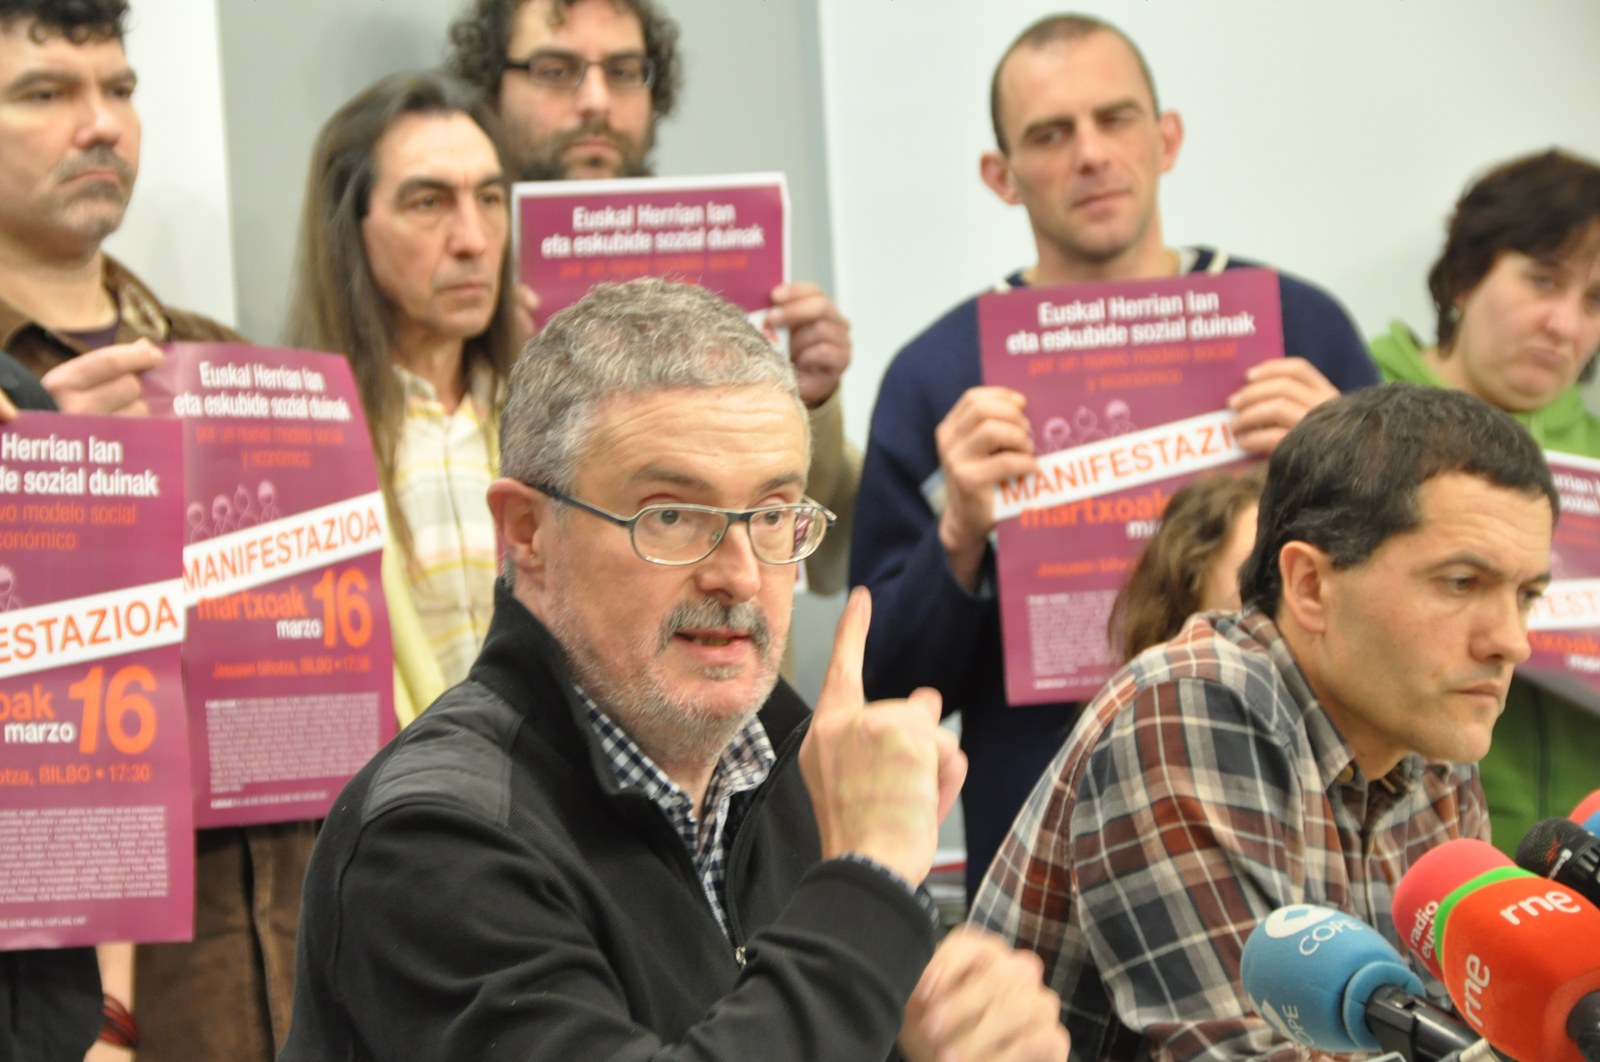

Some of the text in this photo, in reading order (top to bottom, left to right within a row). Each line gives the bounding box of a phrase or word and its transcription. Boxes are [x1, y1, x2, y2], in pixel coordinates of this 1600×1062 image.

[572, 204, 634, 231] Euskal
[637, 203, 704, 226] Herrian
[541, 223, 765, 258] eta eskubide sozial duinak
[1038, 298, 1105, 326] Euskal
[1110, 294, 1183, 319] Herrian
[1006, 312, 1255, 354] eta eskubide sozial duinak
[199, 361, 251, 388] Euskal
[253, 363, 302, 391] Herrian
[173, 391, 203, 417] eta
[204, 391, 269, 417] eskubide
[1, 432, 84, 463] Herrian
[24, 467, 85, 495] sozial
[89, 468, 159, 497] duinak
[23, 502, 85, 523] modelo
[91, 503, 136, 524] social
[182, 507, 381, 593] MANIFESTAZIOA
[197, 584, 308, 621] martxoak
[276, 567, 373, 648] marzo 16
[0, 595, 178, 664] ESTAZIOA
[4, 722, 76, 743] marzo
[68, 664, 158, 755] 16
[39, 764, 91, 785] BILBO
[109, 764, 151, 783] 17:30
[1410, 900, 1440, 948] radio
[1500, 891, 1582, 925] rne
[1299, 919, 1363, 956] COPE
[1464, 953, 1490, 1028] rne
